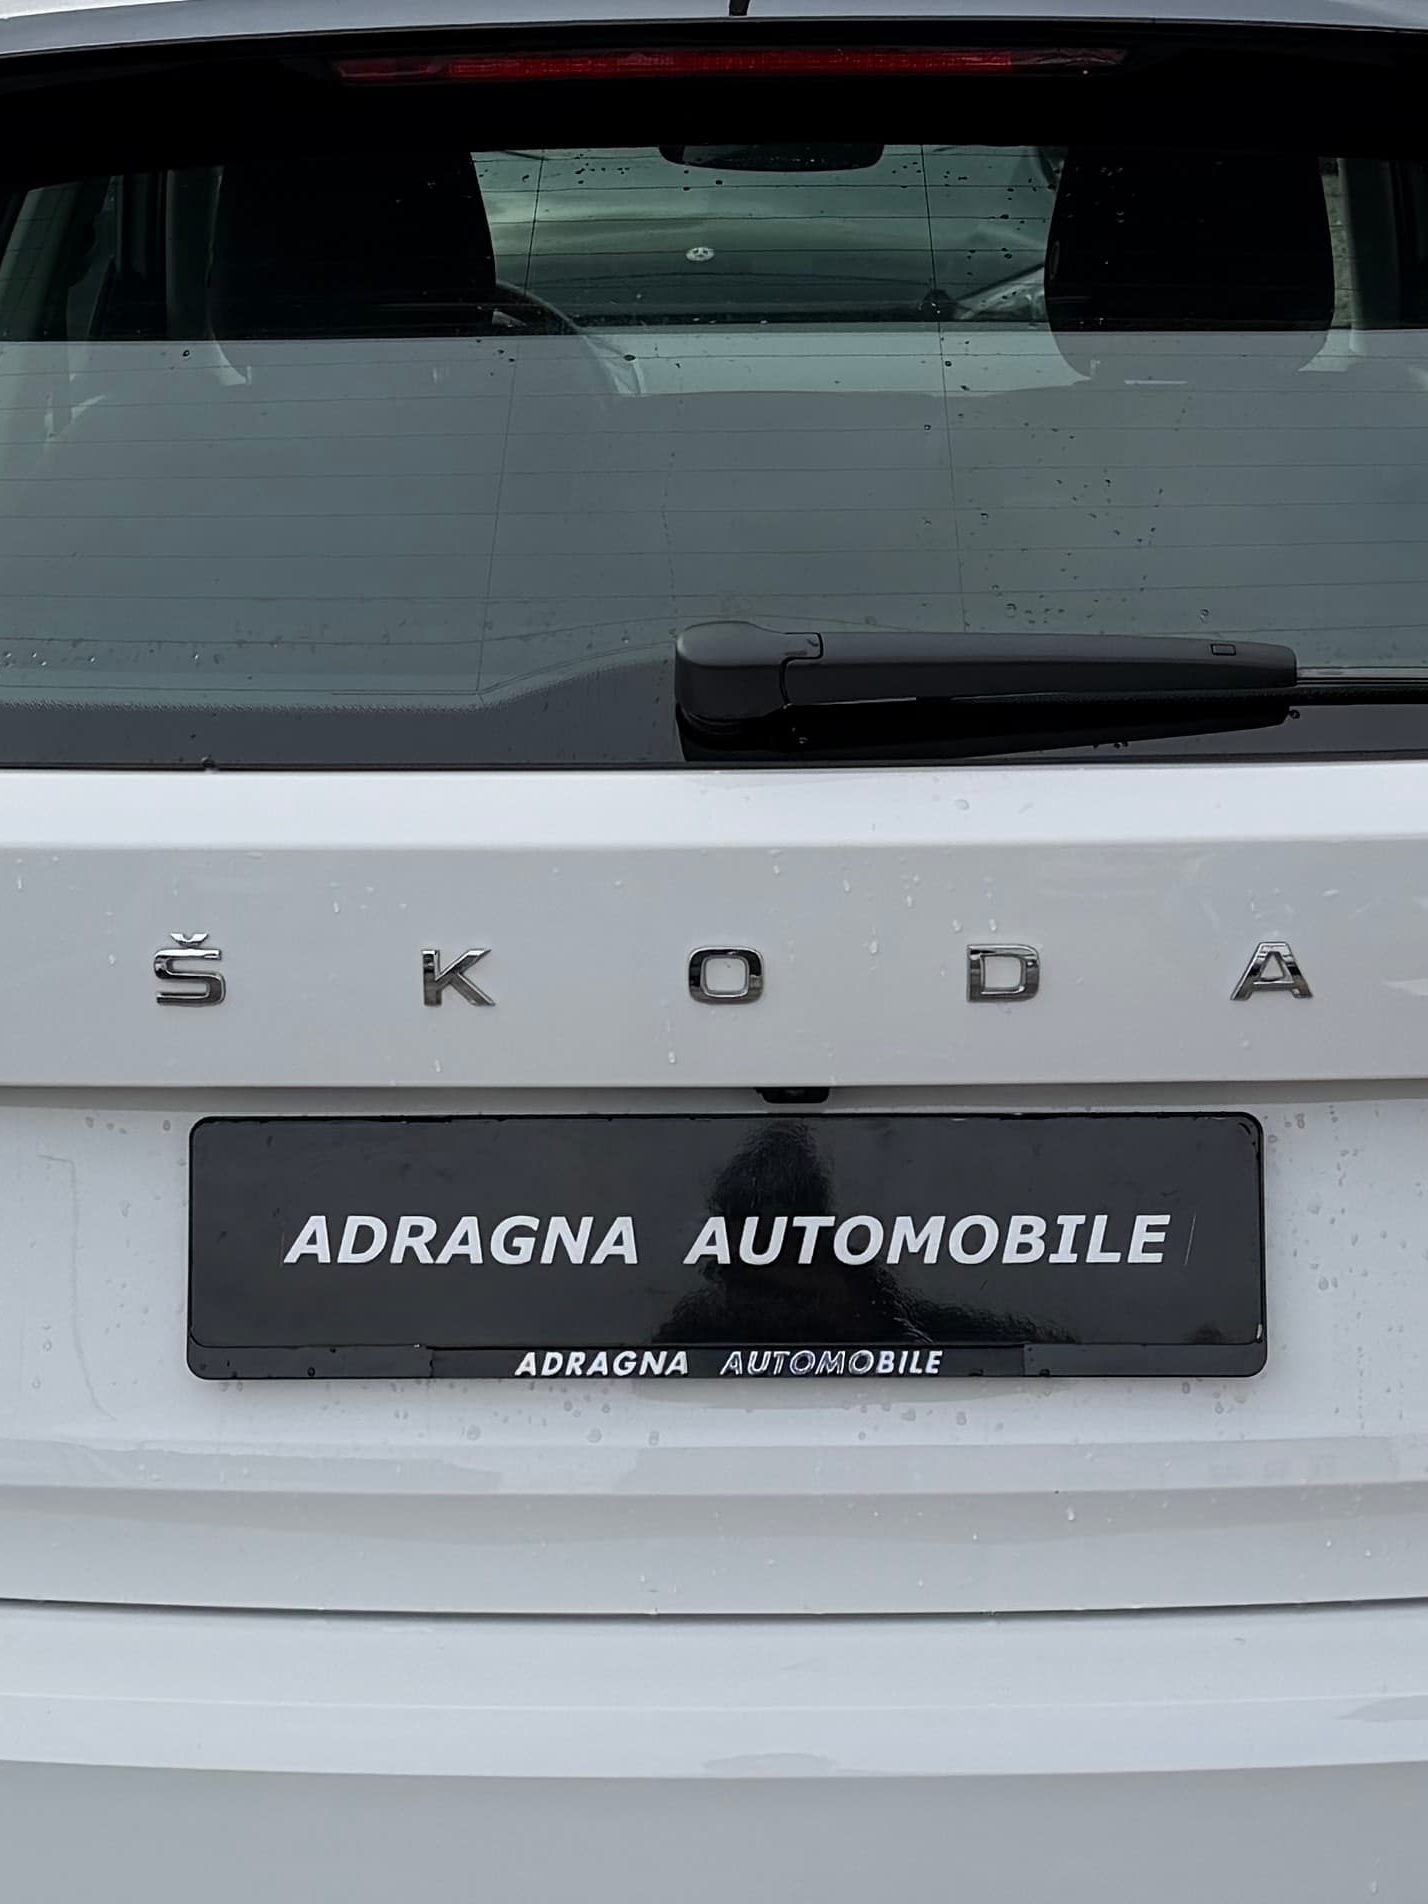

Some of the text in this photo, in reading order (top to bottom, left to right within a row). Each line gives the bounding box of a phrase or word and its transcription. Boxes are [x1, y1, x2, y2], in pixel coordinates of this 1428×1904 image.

[283, 1214, 1171, 1265] ADRAGNA AUTOMOBILE
[515, 1350, 943, 1377] ADRAGNA AUTOMOBILE
